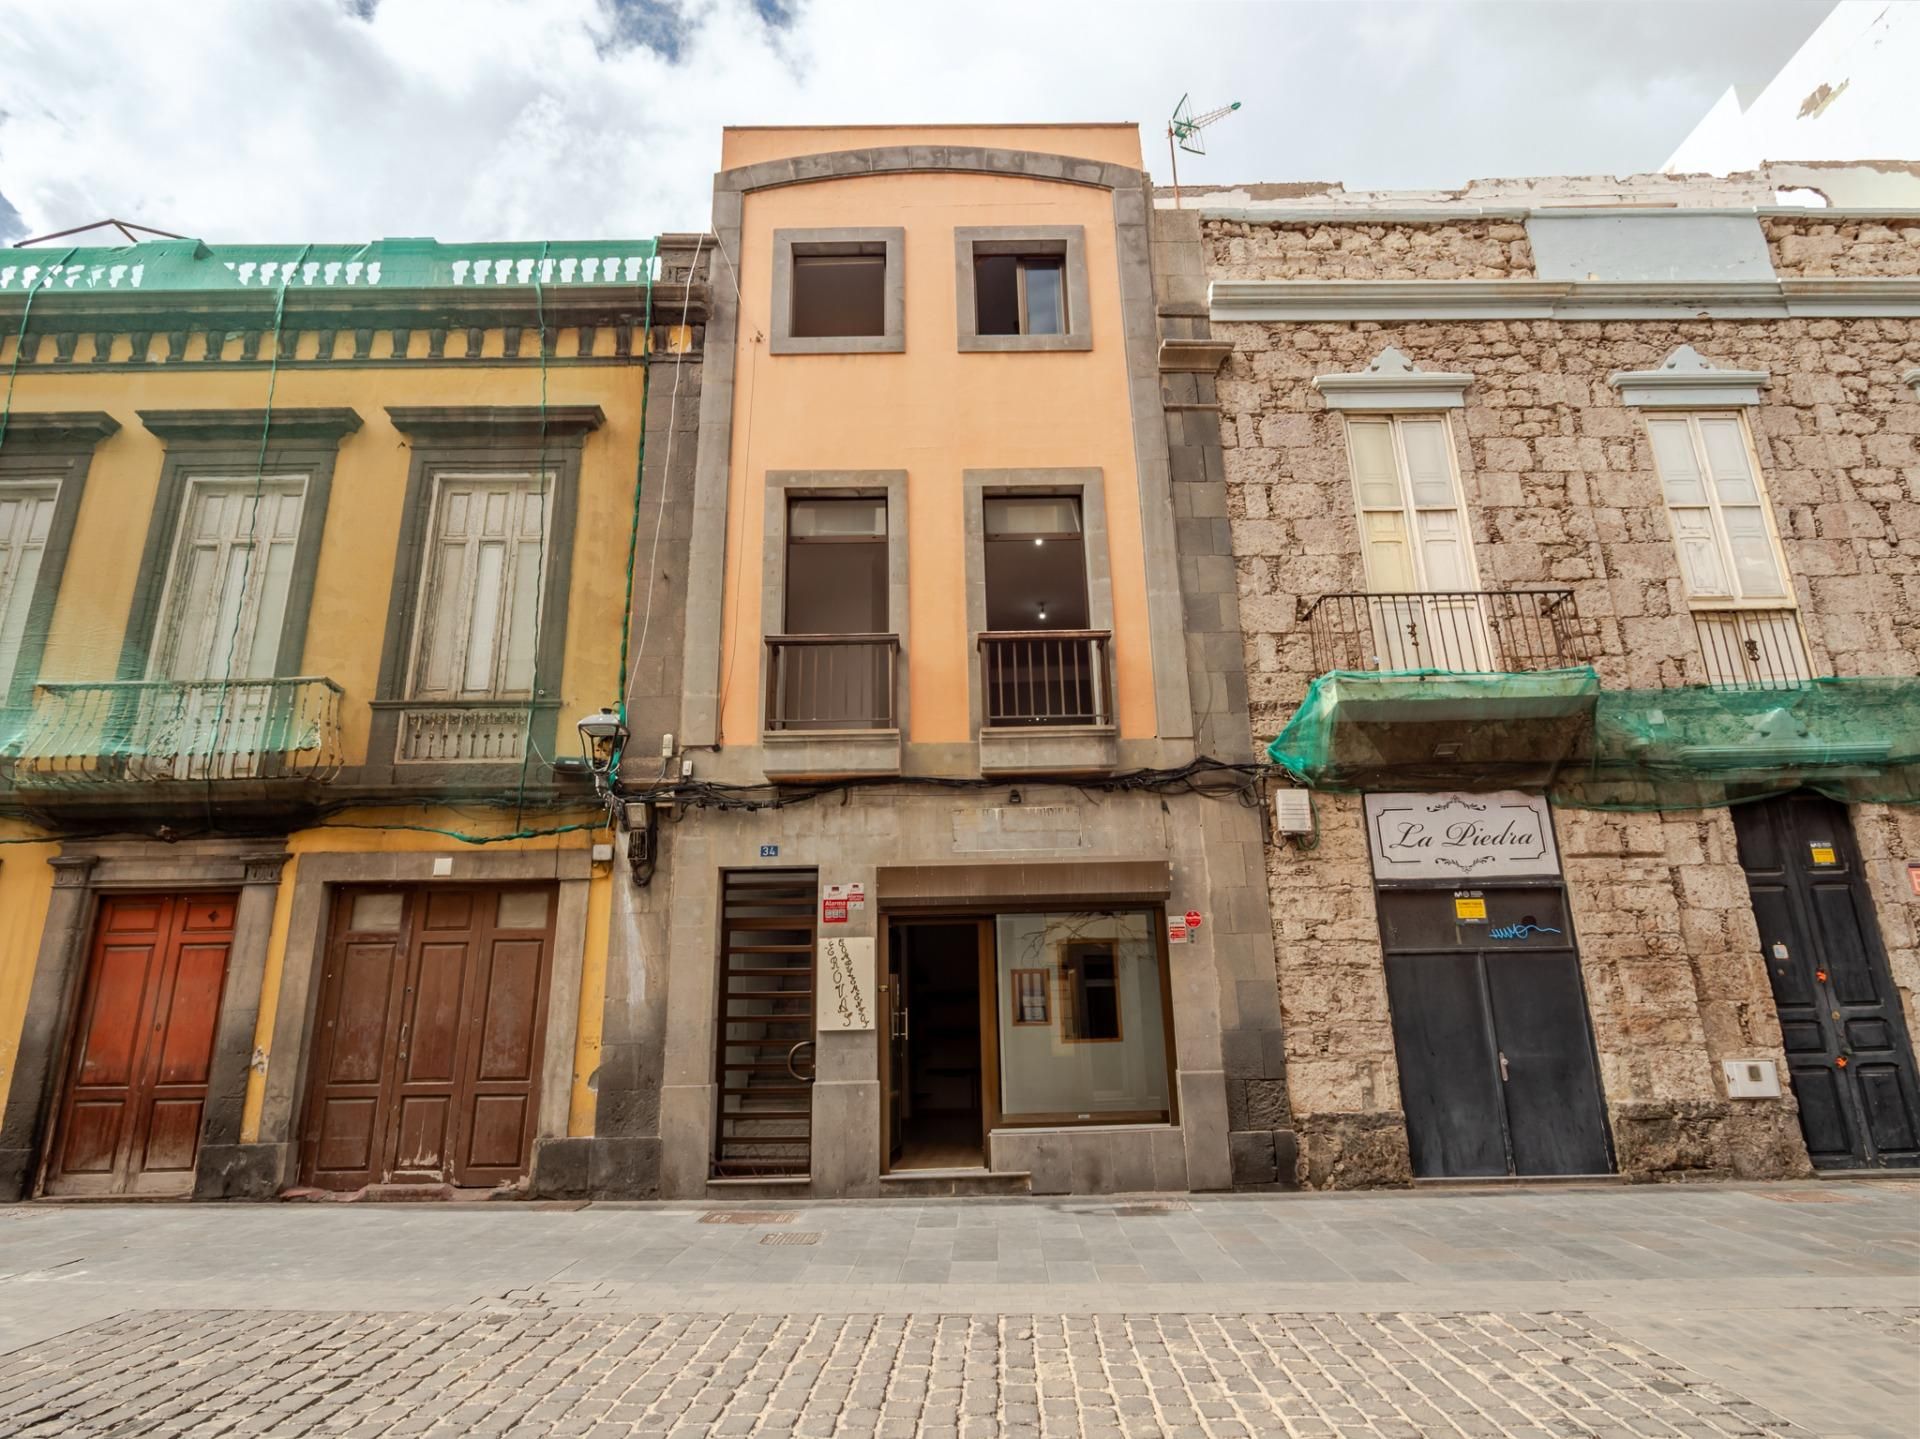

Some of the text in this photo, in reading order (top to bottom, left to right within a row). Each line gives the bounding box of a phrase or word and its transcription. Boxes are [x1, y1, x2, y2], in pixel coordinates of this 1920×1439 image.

[1389, 819, 1534, 848] La Piedra
[762, 847, 776, 856] 34
